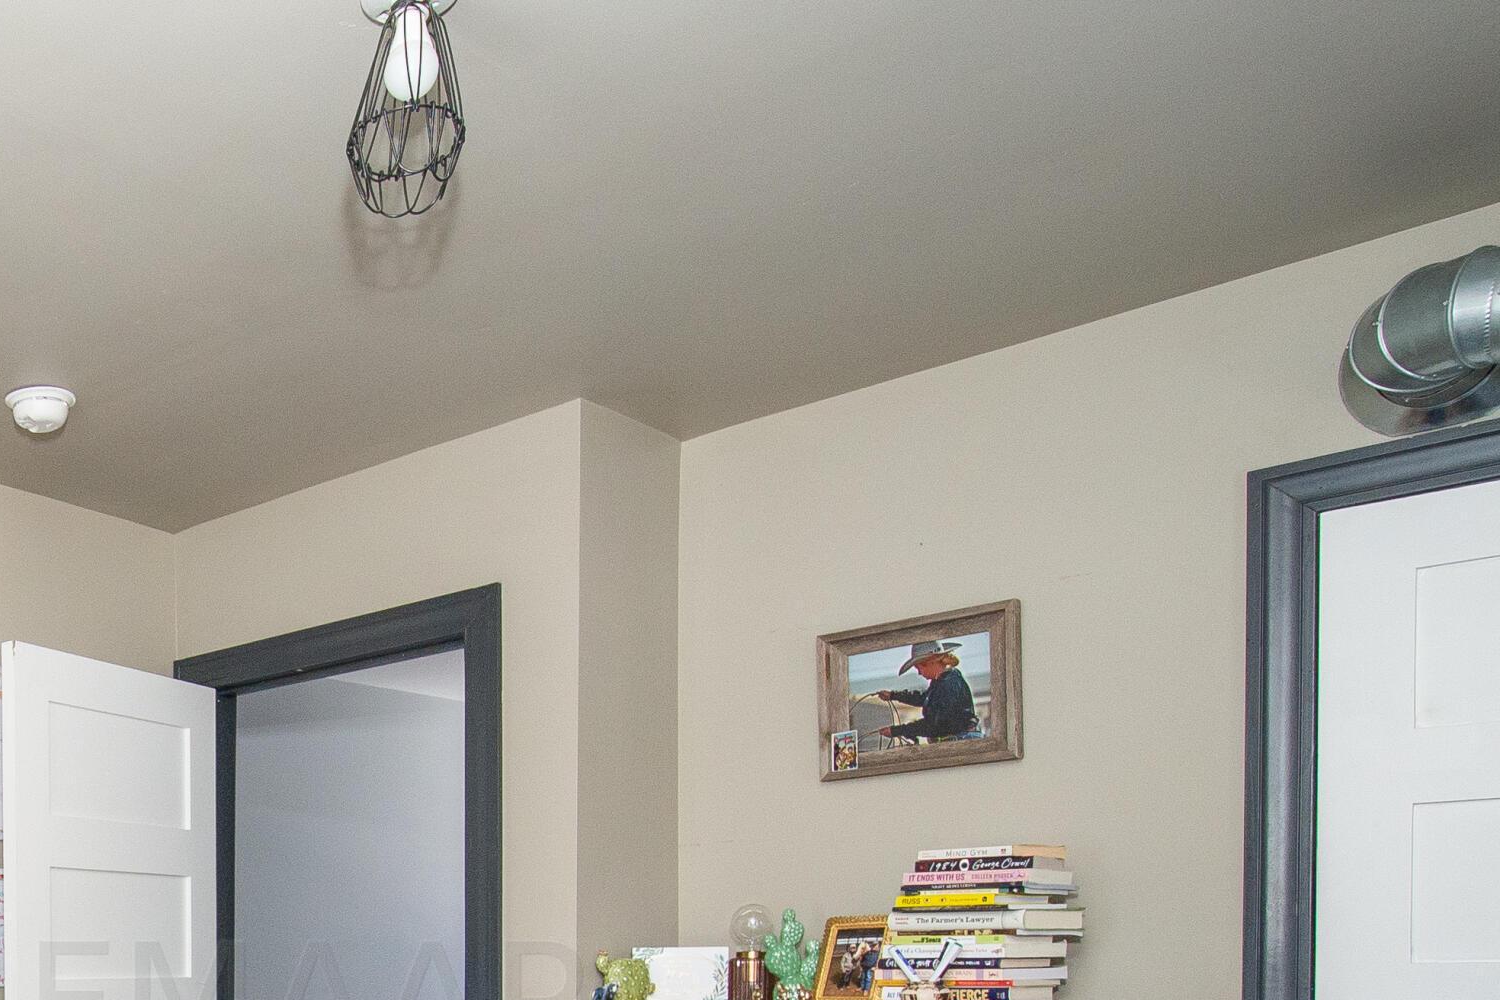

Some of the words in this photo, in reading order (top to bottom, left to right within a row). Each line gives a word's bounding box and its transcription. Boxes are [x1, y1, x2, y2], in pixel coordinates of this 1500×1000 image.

[928, 861, 958, 872] 1984
[971, 859, 1000, 870] George
[1000, 857, 1030, 869] Orwell
[916, 874, 935, 882] ENDS
[936, 873, 954, 881] WITH
[955, 873, 965, 881] US
